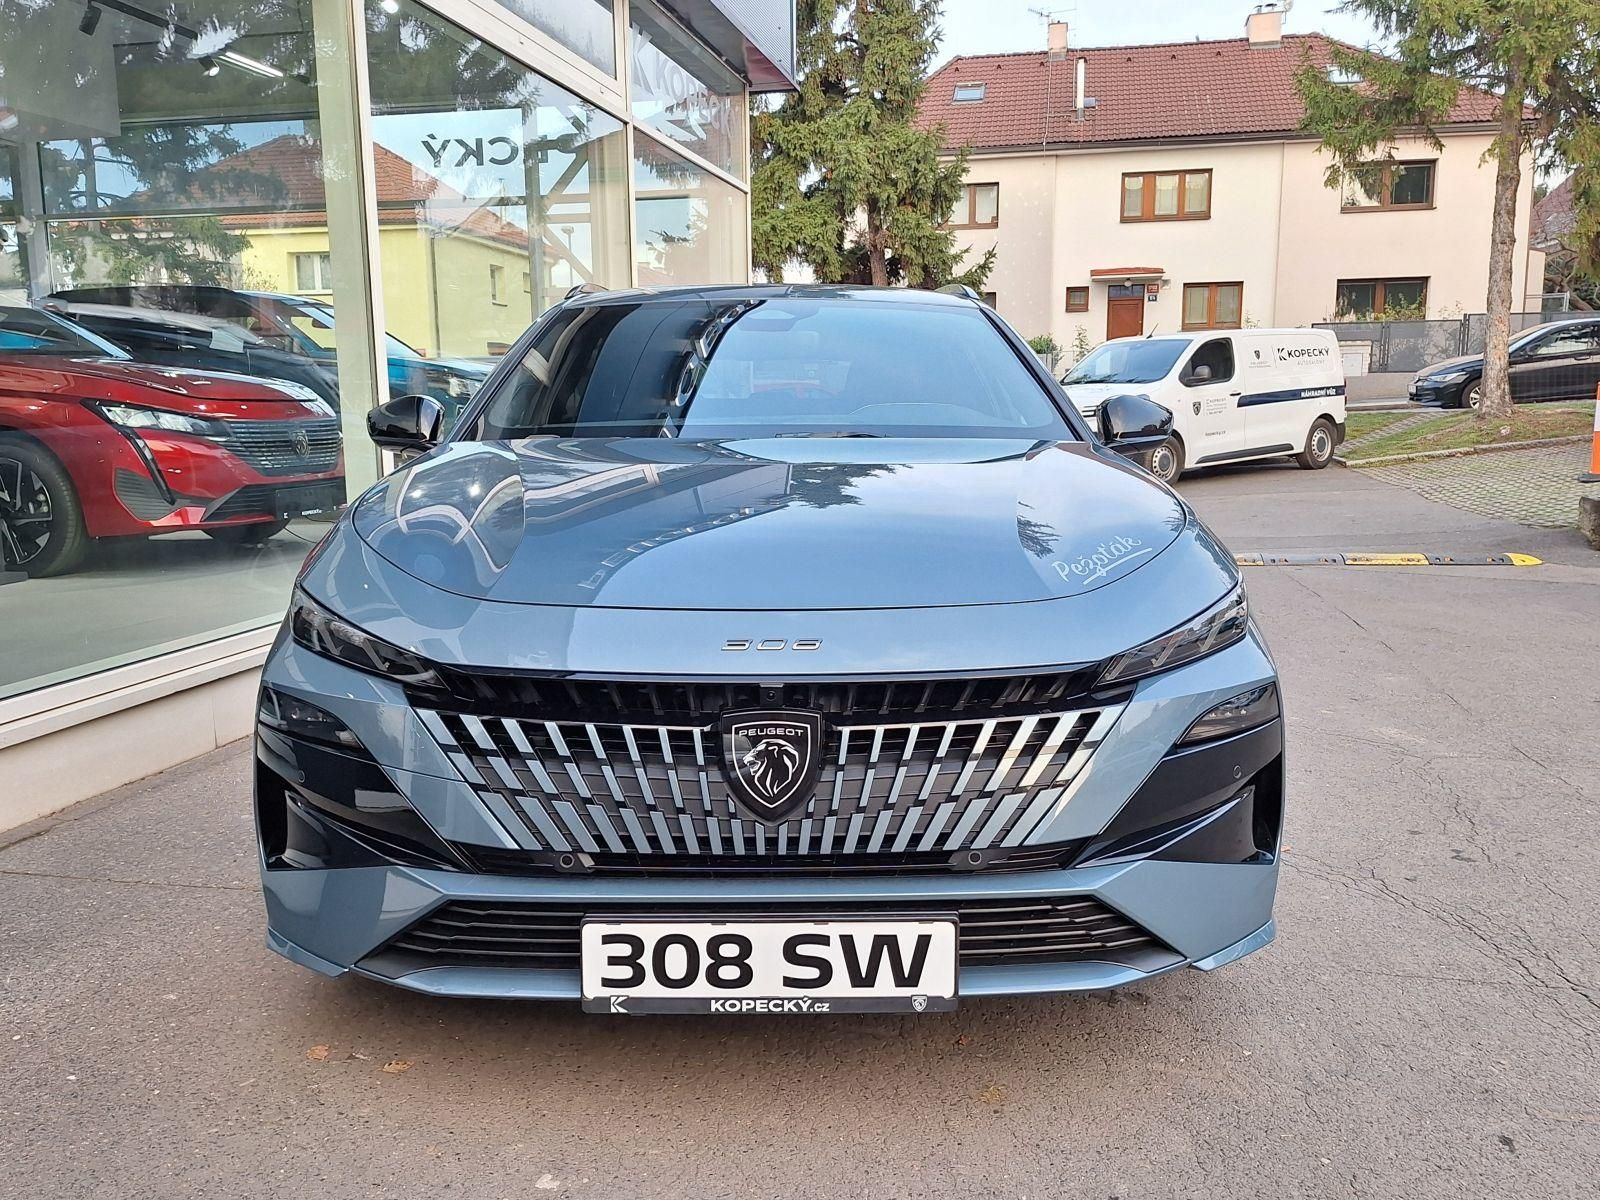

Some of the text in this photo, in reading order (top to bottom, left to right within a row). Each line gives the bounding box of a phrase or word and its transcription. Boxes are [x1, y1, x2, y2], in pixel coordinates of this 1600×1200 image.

[1287, 346, 1330, 359] KOPECKÝ
[721, 639, 823, 651] 308
[738, 728, 804, 737] PEUGEOT
[600, 932, 932, 989] 308 SW
[710, 997, 830, 1013] KOPECKÝ.cz
